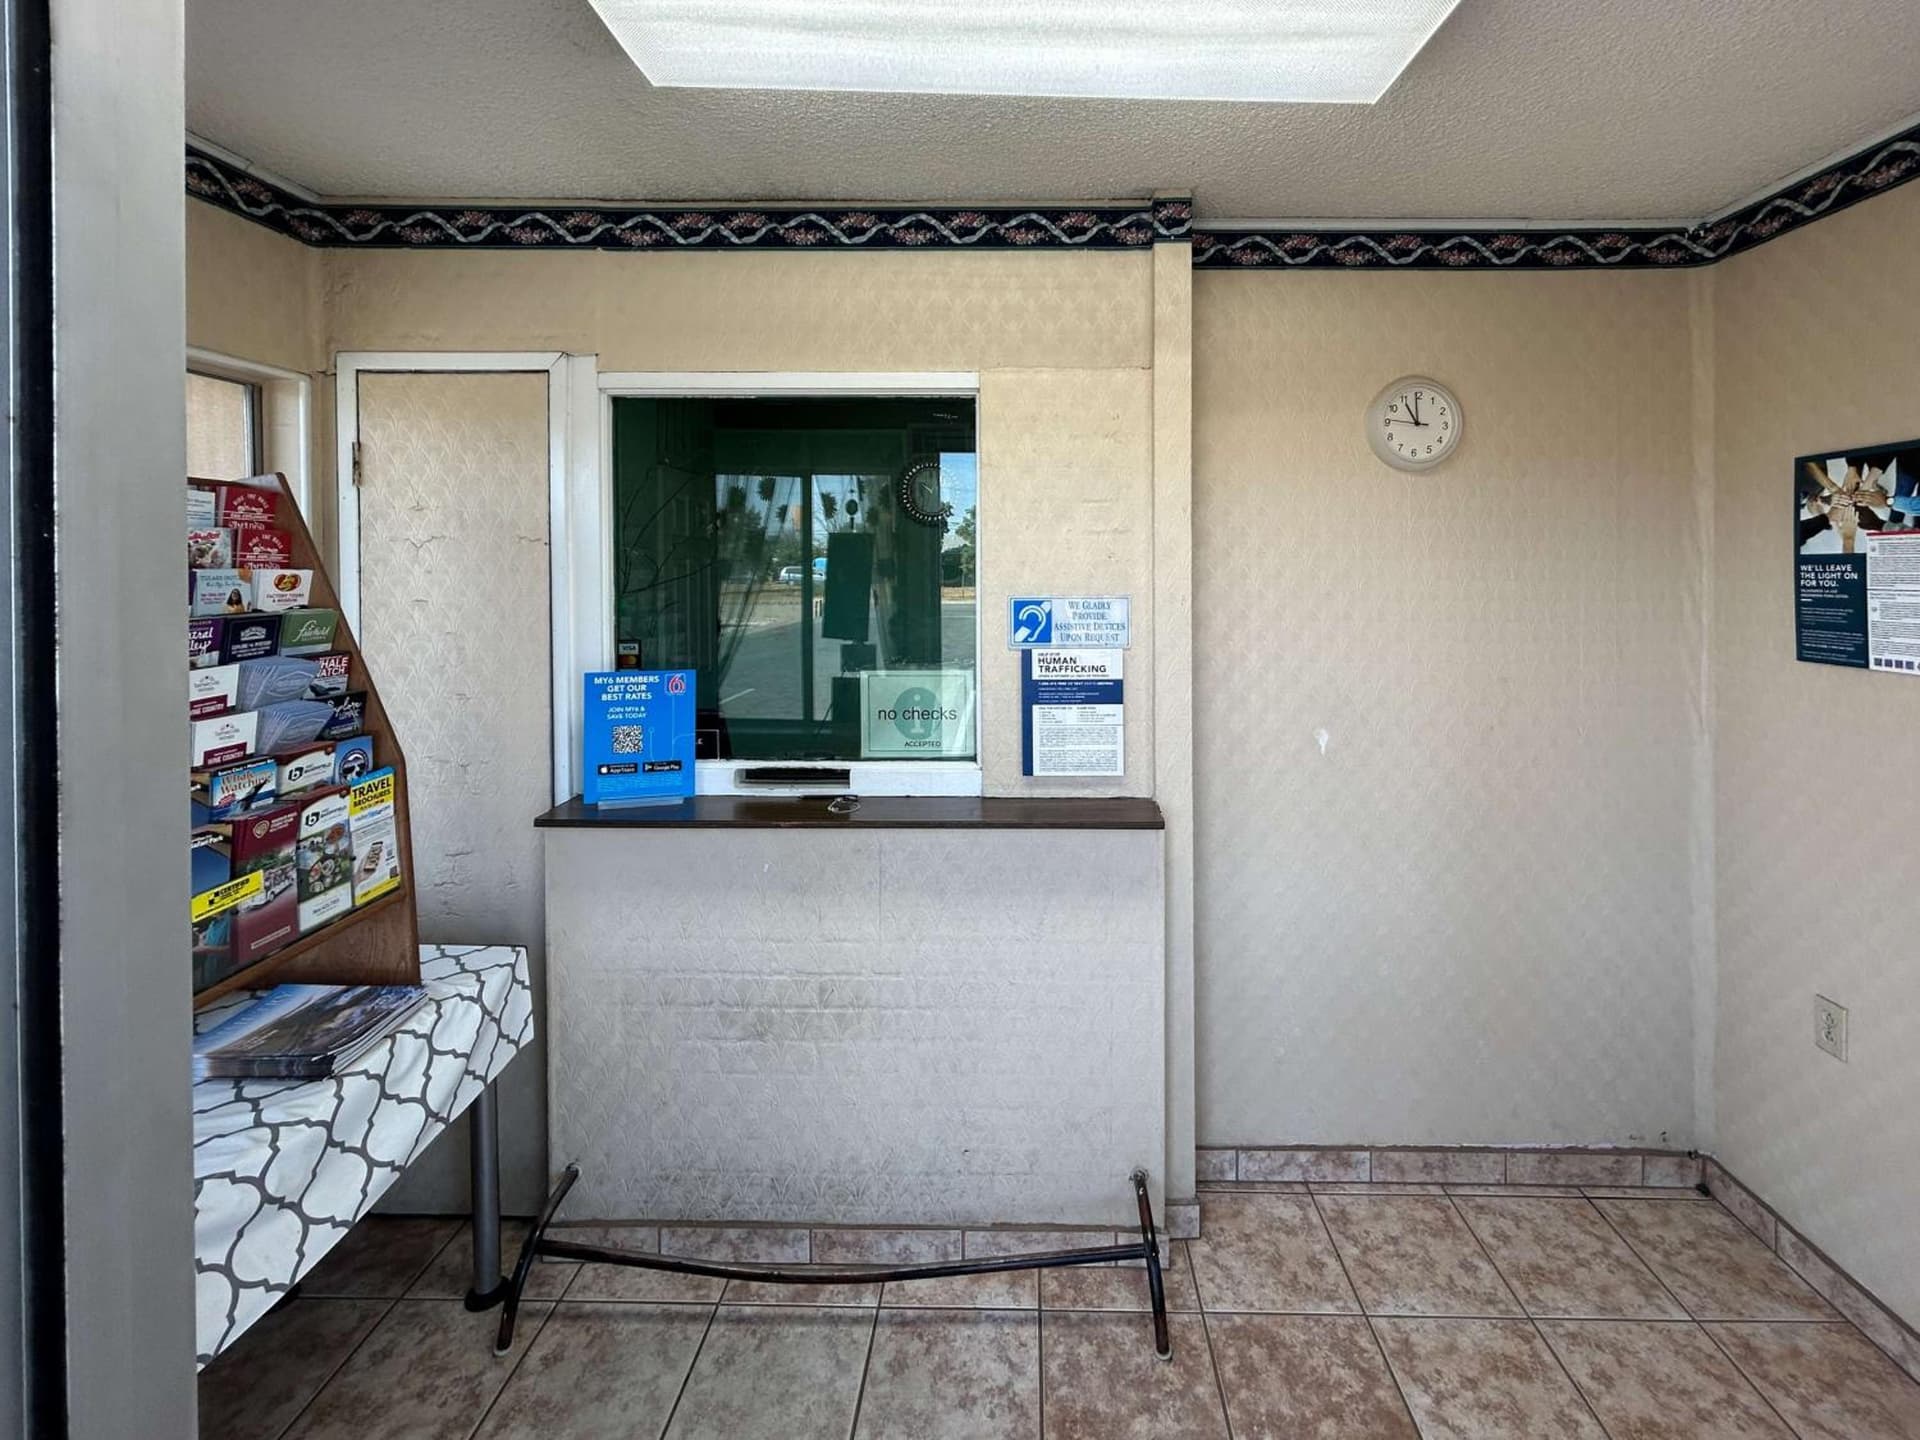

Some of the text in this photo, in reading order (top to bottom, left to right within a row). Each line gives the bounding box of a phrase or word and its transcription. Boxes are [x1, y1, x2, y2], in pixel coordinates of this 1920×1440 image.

[1431, 397, 1435, 405] 1
[1389, 404, 1398, 413] 10
[1440, 407, 1446, 416] 2
[1384, 418, 1391, 427] 9
[1441, 422, 1449, 431] 3
[1387, 432, 1394, 441] 8
[1436, 435, 1443, 444] 4
[1398, 443, 1404, 452] 7
[1426, 445, 1432, 454] 5
[1411, 449, 1417, 457] 6
[1800, 564, 1852, 572] WE'LL LEAVE
[1817, 572, 1842, 580] LIGHT
[1844, 572, 1858, 580] ON
[1800, 579, 1817, 587] FOR
[1082, 600, 1112, 610] GLADLY
[1072, 612, 1106, 620] PROVIDE
[1054, 622, 1126, 631] ASSISTIVE DEVICES
[1060, 633, 1120, 643] UPON REQUEST
[318, 656, 350, 669] HALE
[1038, 657, 1077, 665] HUMAN
[1038, 665, 1107, 673] TRAFFICKING
[594, 675, 660, 685] MY6 MEMBERS
[626, 684, 647, 692] OUR
[601, 692, 653, 701] BEST RATES
[878, 706, 957, 721] no checks
[904, 740, 941, 748] ACCEPTED
[352, 777, 392, 799] TRAVEL
